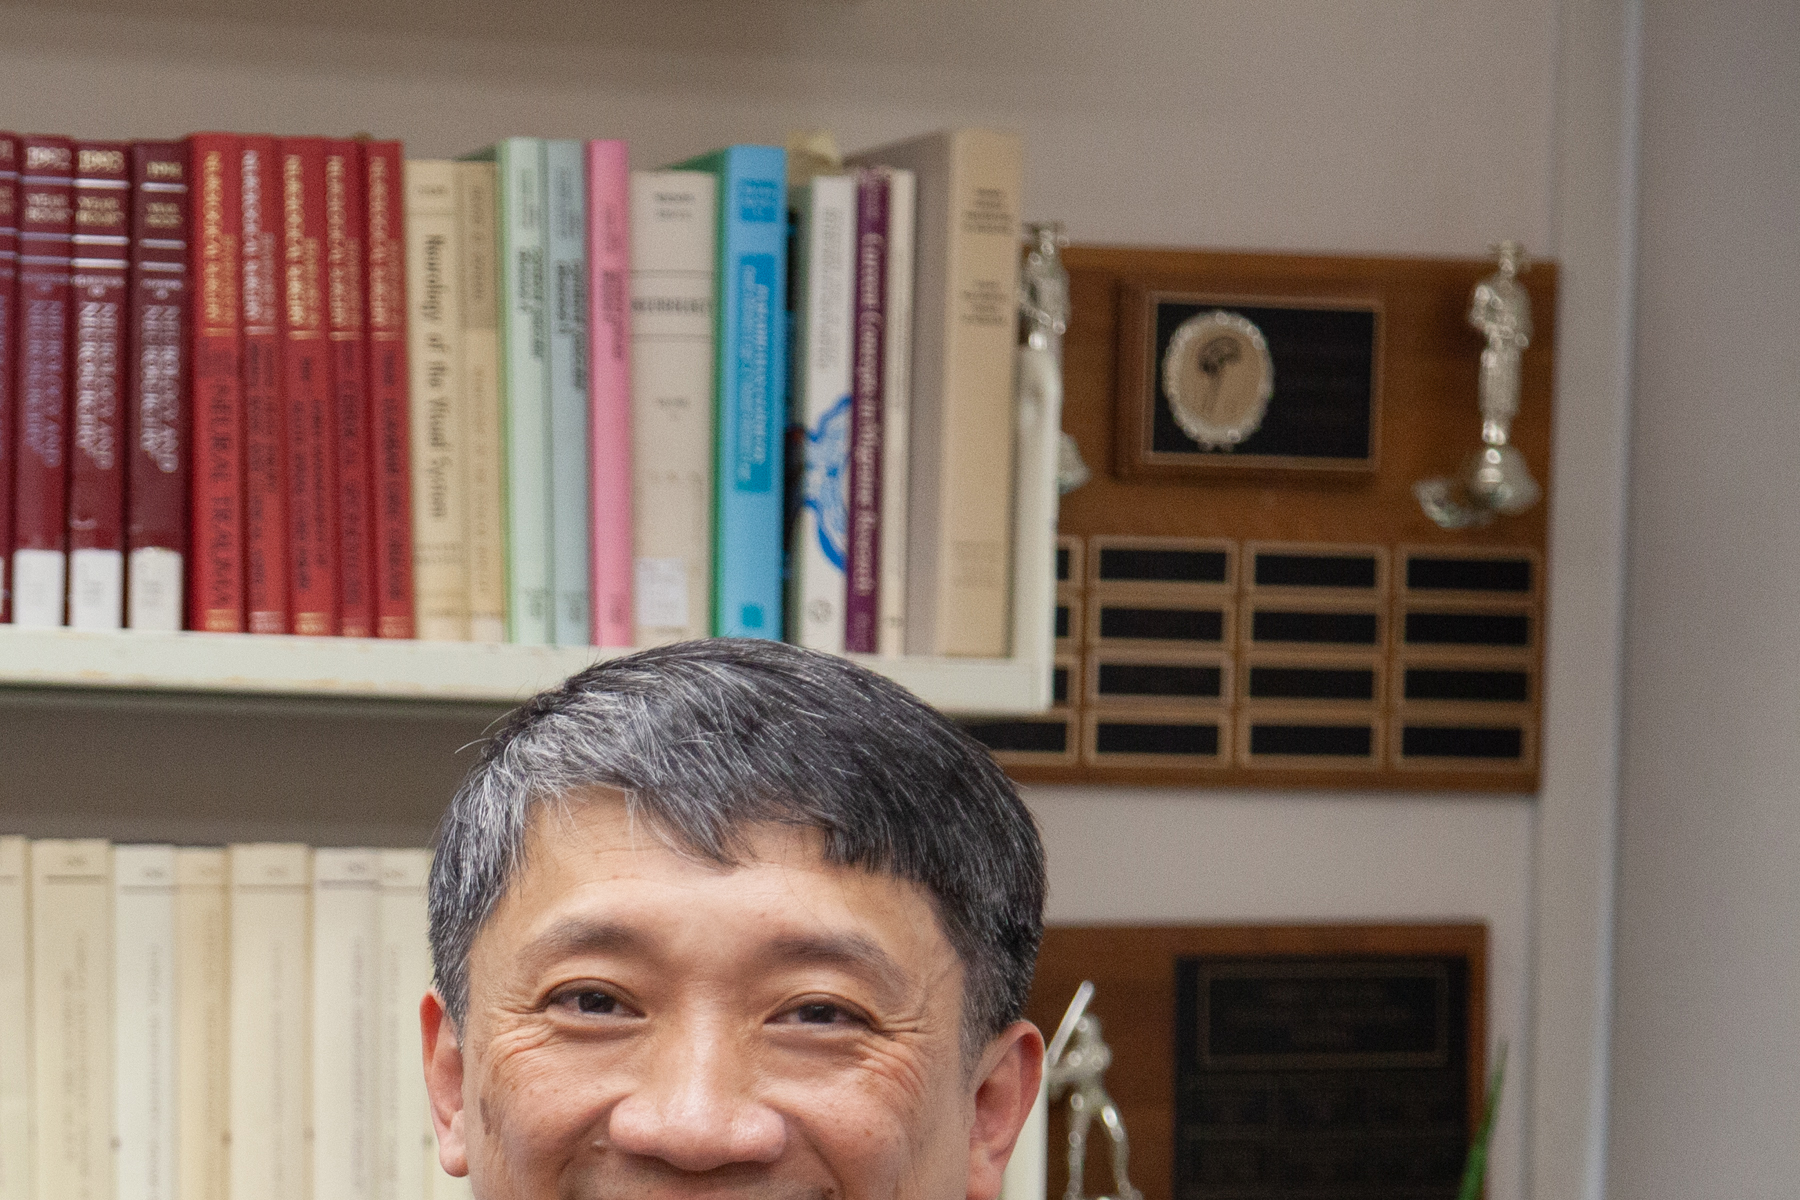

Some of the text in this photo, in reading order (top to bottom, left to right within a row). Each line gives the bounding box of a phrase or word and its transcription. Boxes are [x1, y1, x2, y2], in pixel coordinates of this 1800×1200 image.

[421, 234, 452, 518] Neurology of the Visual System
